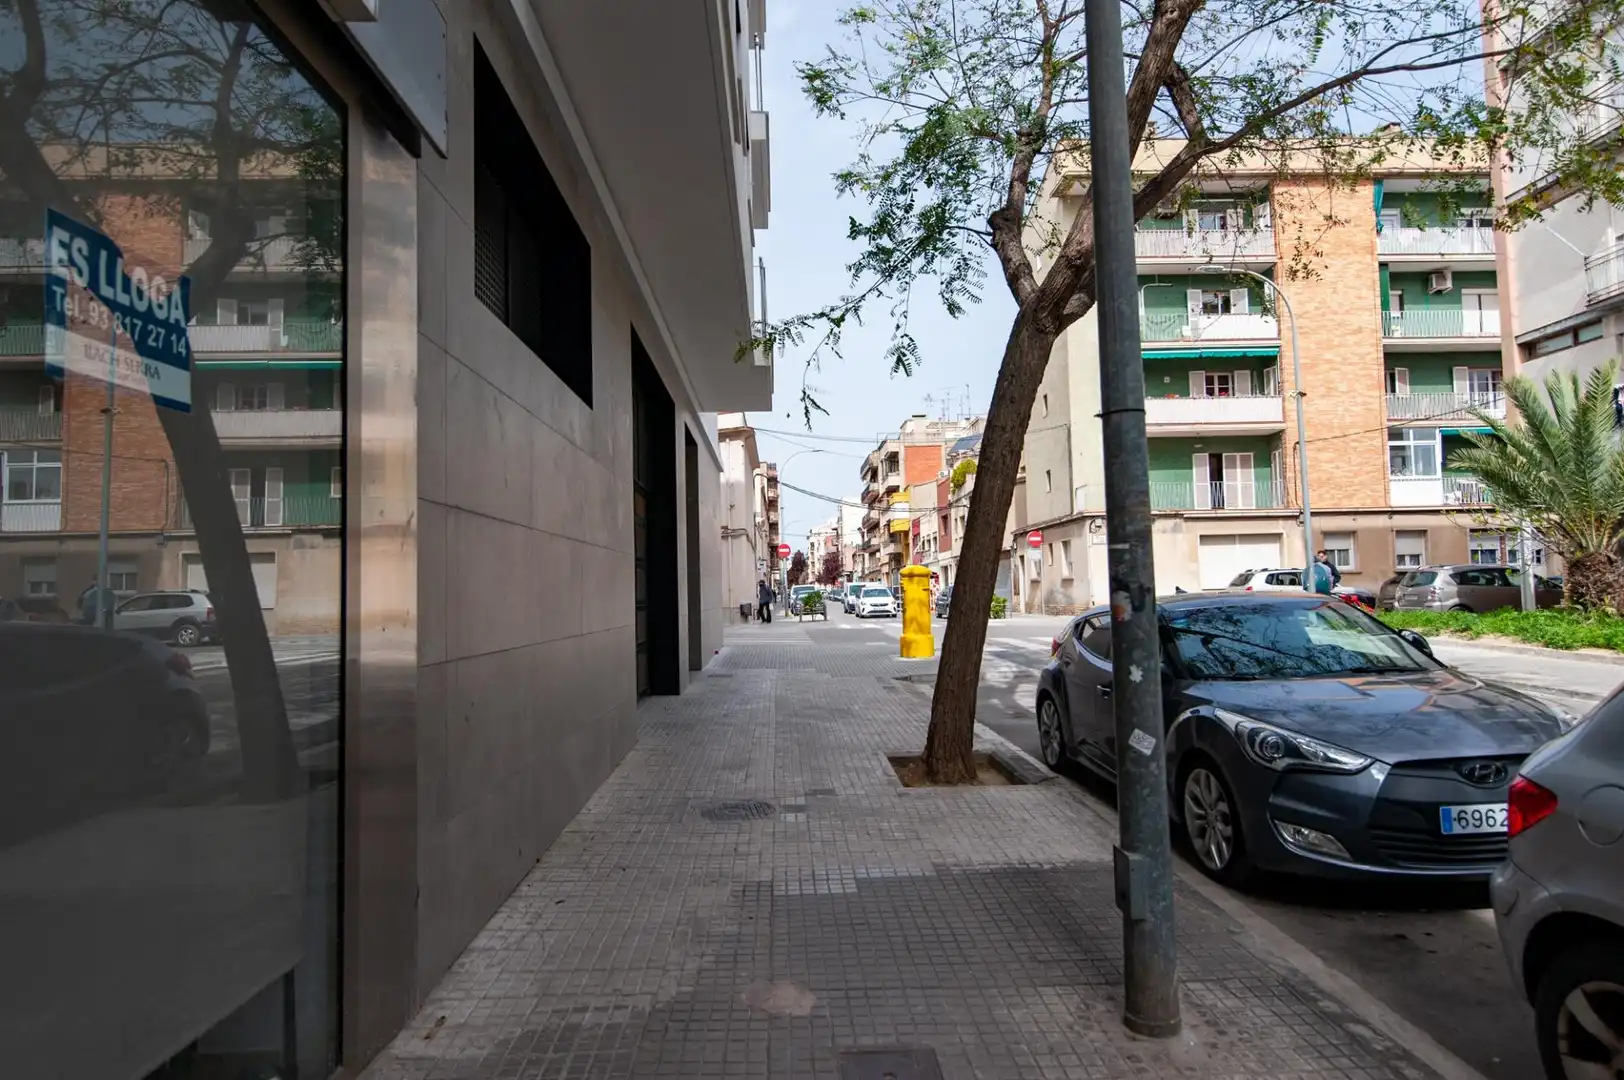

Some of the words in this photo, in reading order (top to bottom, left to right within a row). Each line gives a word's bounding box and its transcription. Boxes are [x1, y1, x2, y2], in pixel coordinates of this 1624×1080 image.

[51, 225, 90, 288] ES
[99, 250, 186, 328] LLOGA
[52, 287, 84, 320] Tel.
[89, 303, 108, 330] 93
[113, 311, 142, 341] 817
[147, 325, 166, 349] 27
[171, 336, 187, 357] 14
[1457, 808, 1509, 830] 6962
